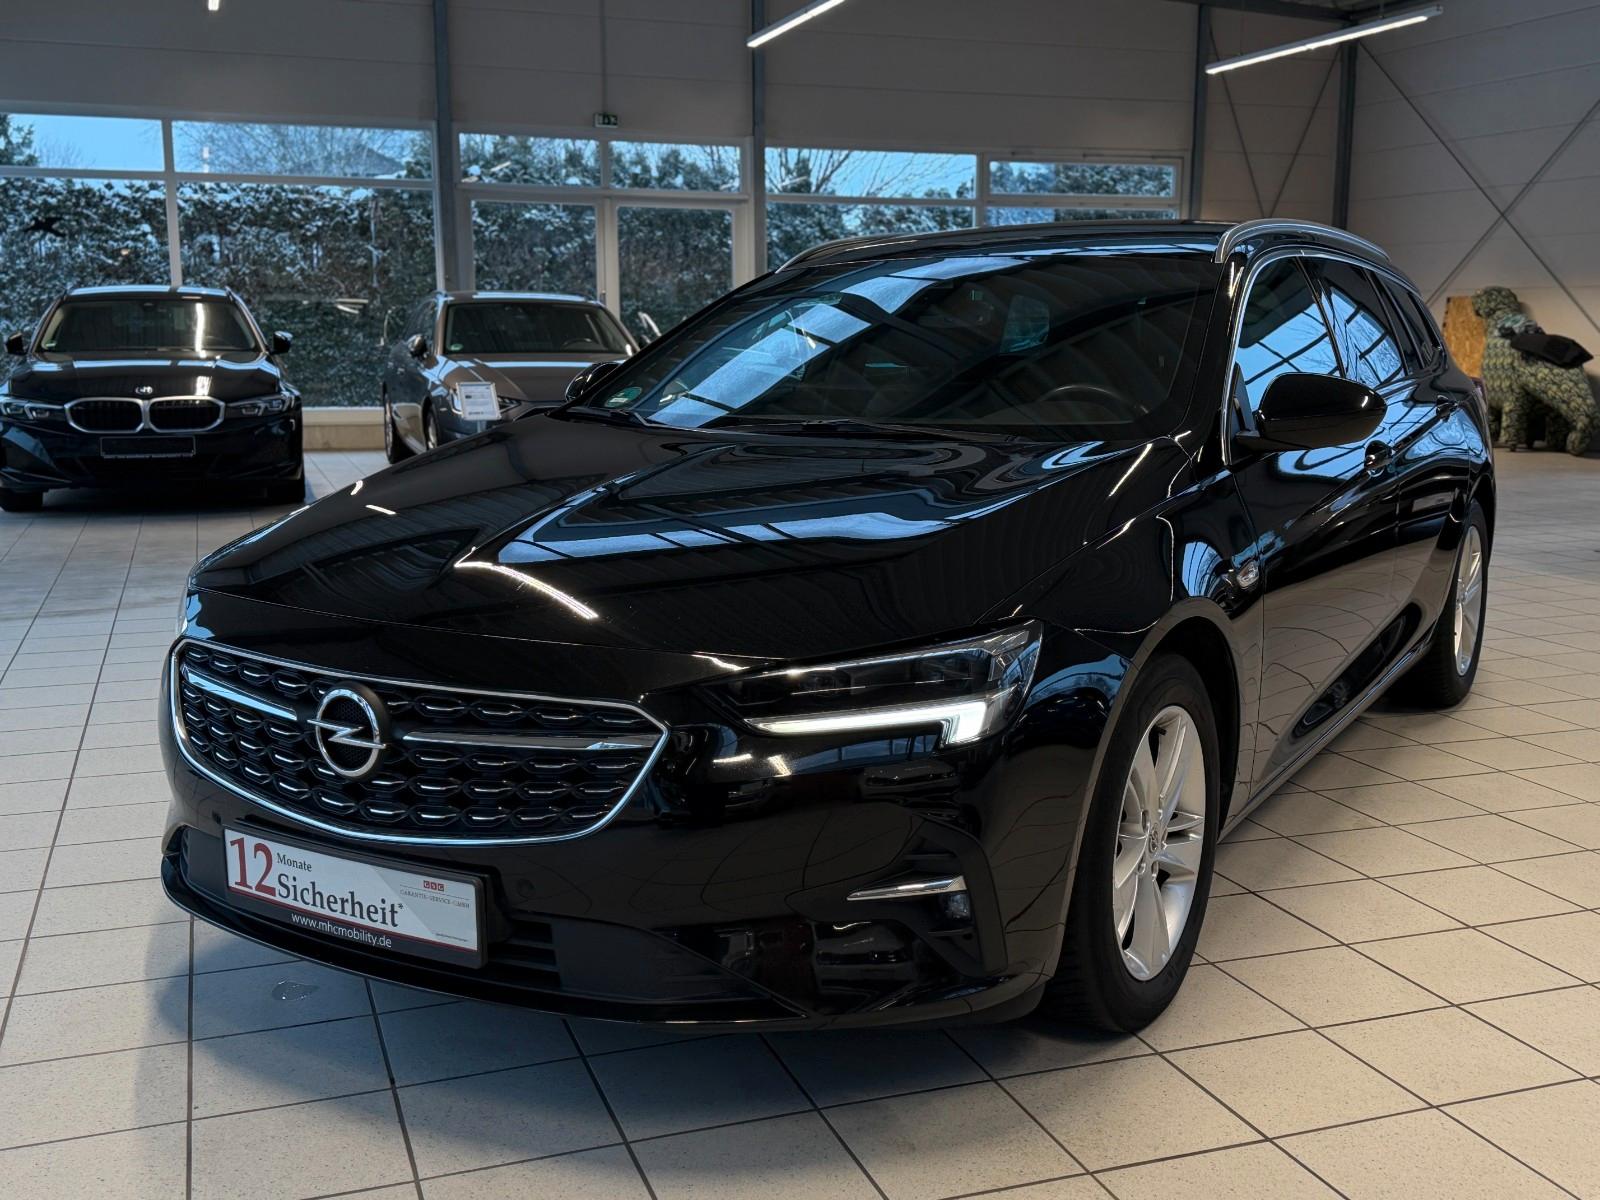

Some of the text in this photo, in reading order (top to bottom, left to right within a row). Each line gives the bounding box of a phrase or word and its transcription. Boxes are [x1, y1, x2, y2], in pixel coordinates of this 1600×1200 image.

[229, 837, 313, 897] 12 Monate
[291, 913, 392, 948] www.mhcmobility.de
